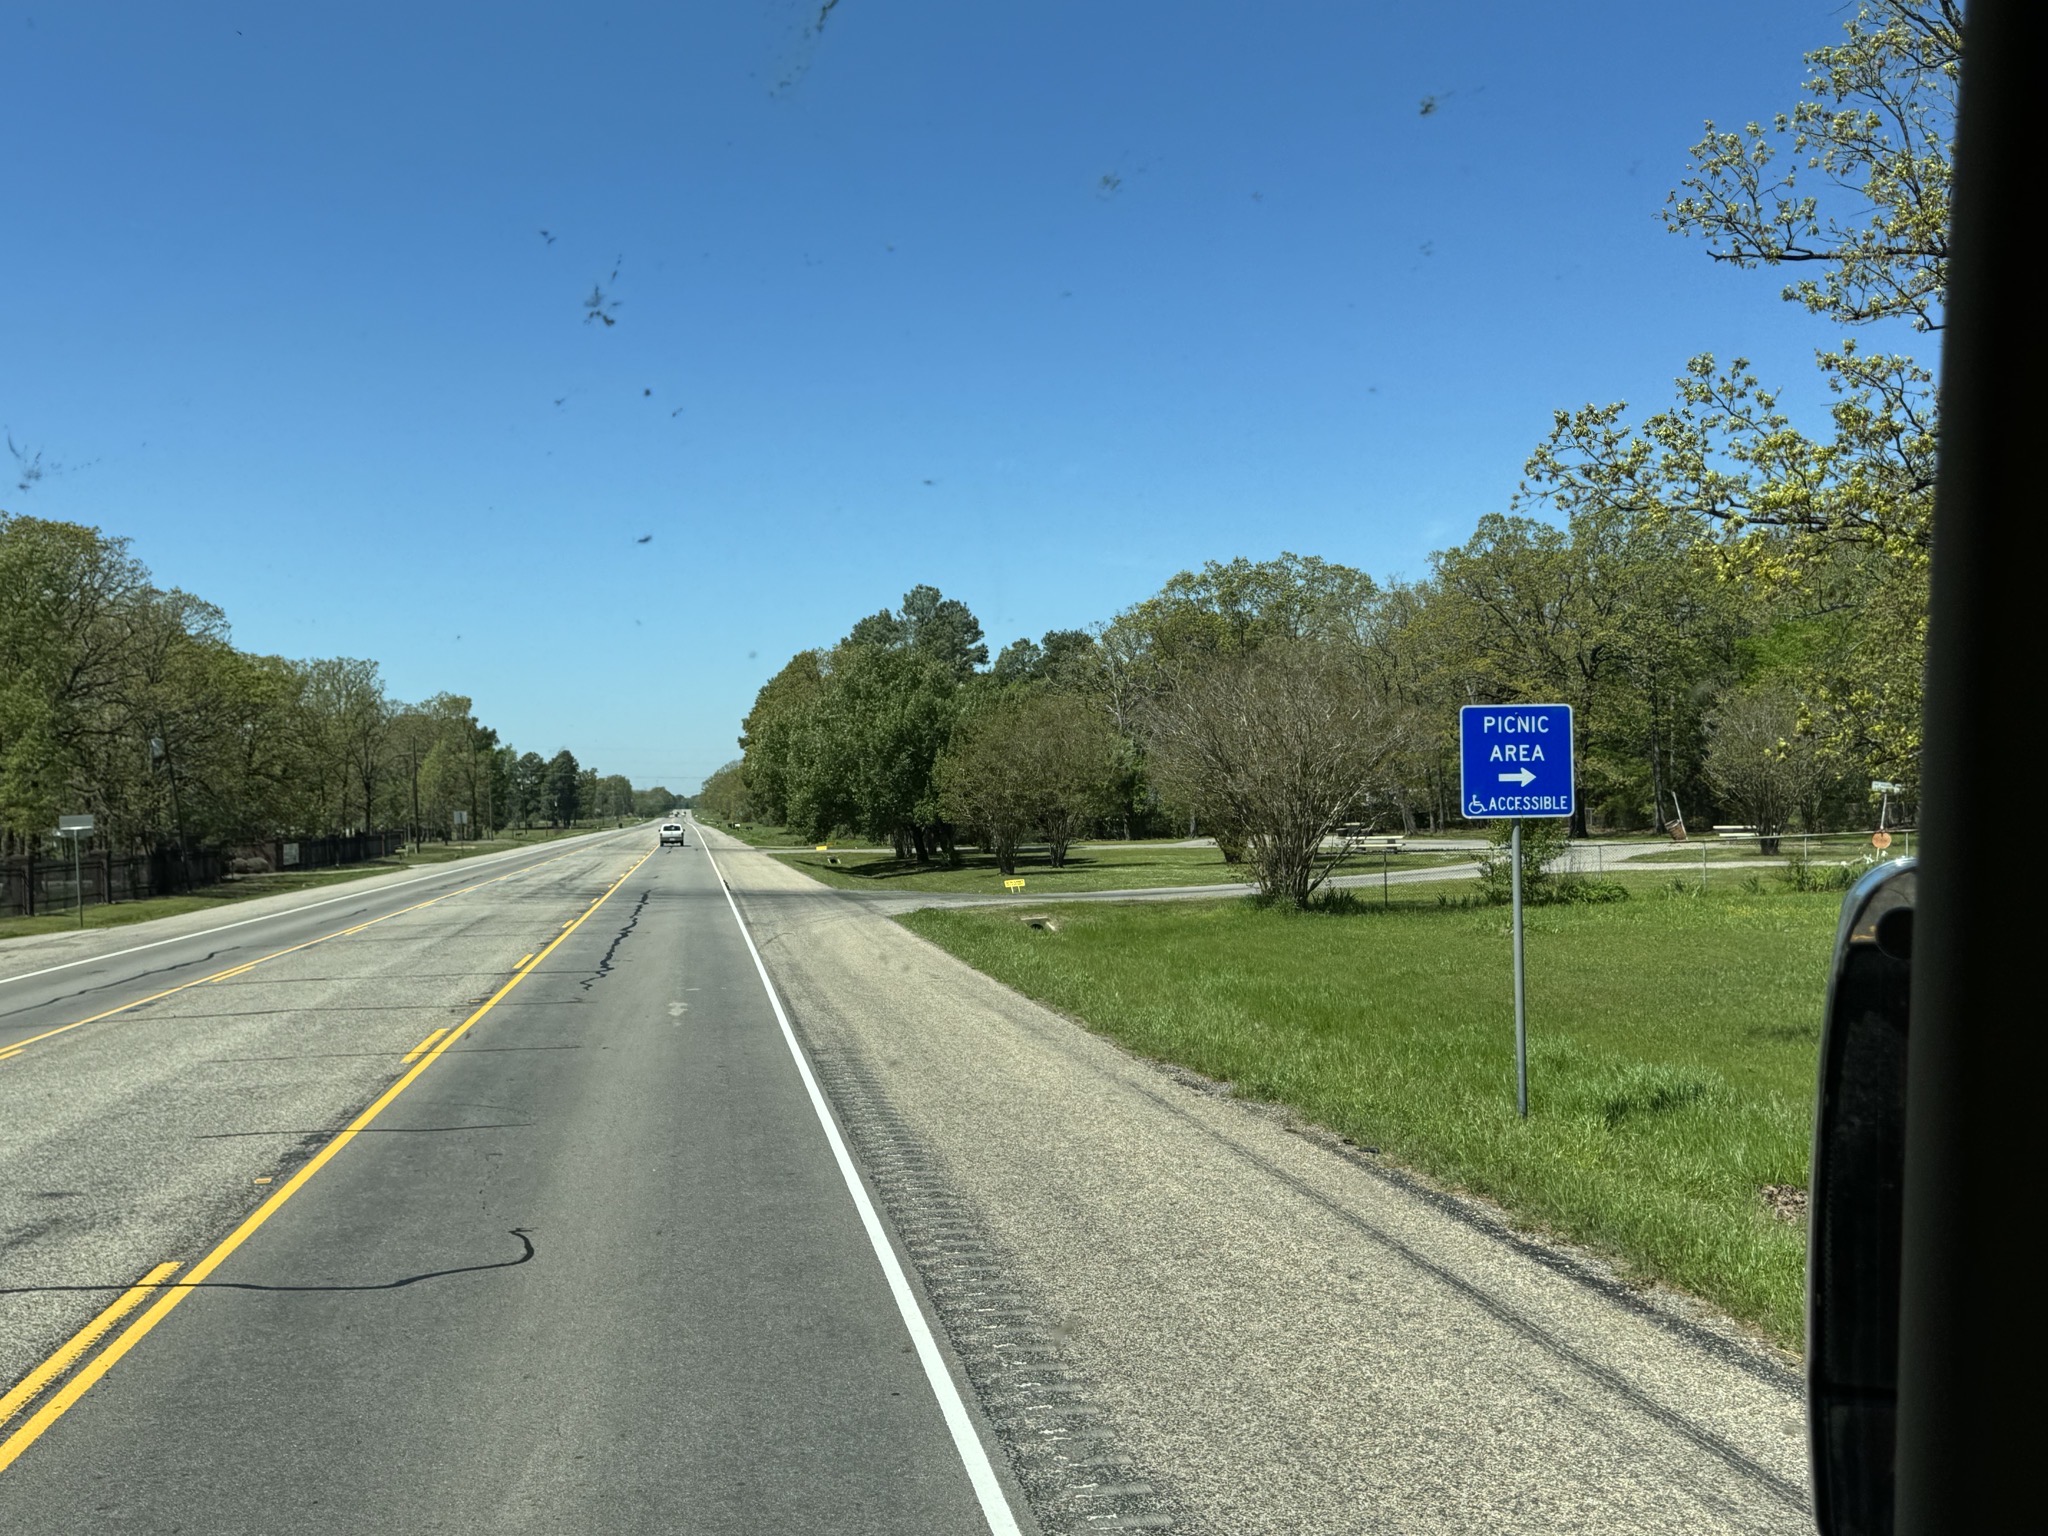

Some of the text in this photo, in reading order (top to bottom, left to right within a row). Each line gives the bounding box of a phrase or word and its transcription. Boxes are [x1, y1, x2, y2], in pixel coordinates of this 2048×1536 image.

[1483, 715, 1549, 734] PICNIC
[1489, 744, 1545, 762] AREA
[1488, 795, 1568, 811] ACCESSIBLE
